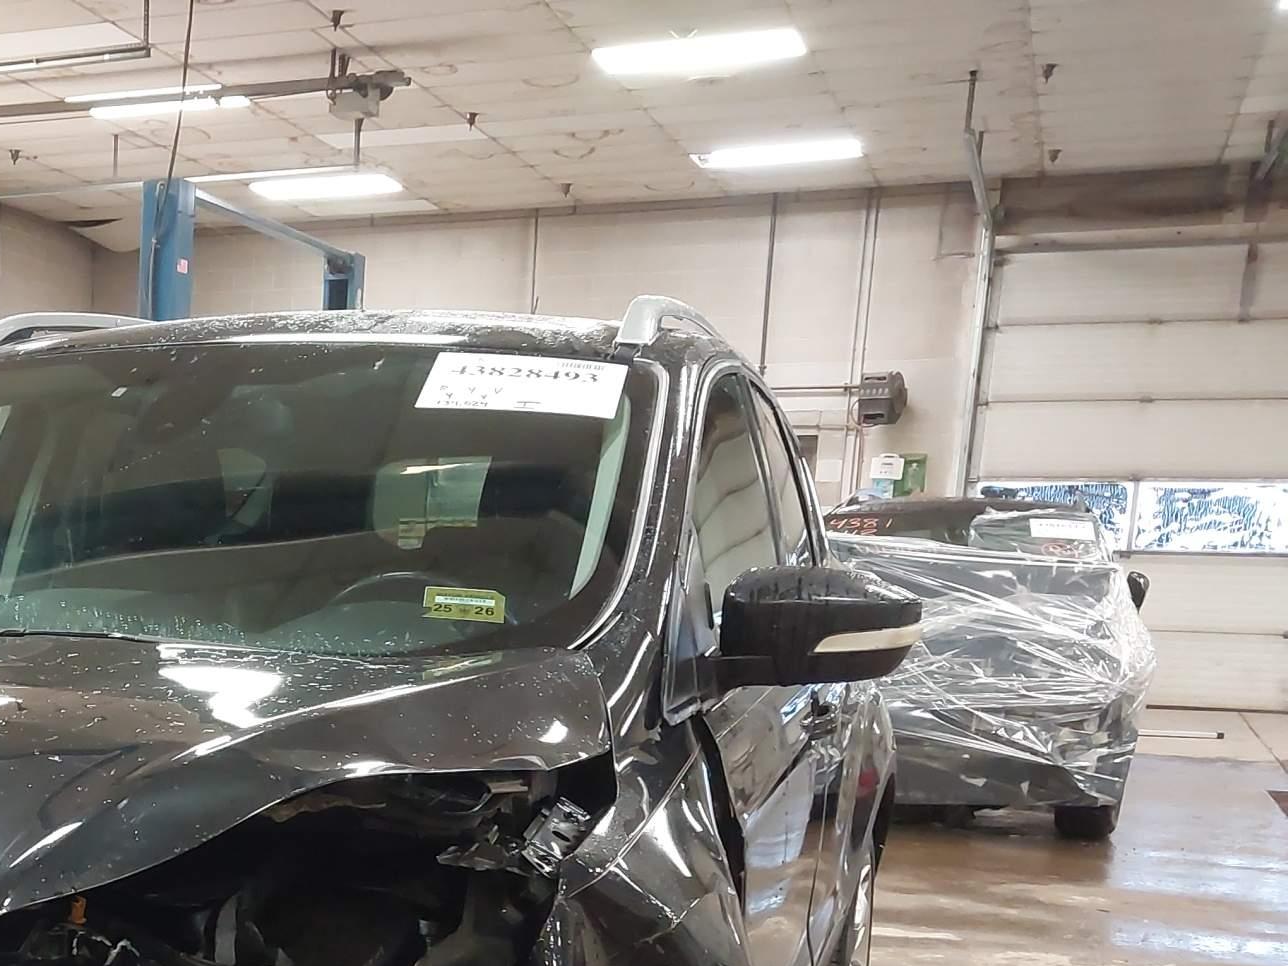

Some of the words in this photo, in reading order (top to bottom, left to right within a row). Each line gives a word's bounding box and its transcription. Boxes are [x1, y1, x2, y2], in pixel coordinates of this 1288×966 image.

[450, 363, 600, 384] 43828493
[432, 603, 453, 613] 25
[474, 606, 495, 616] 26
